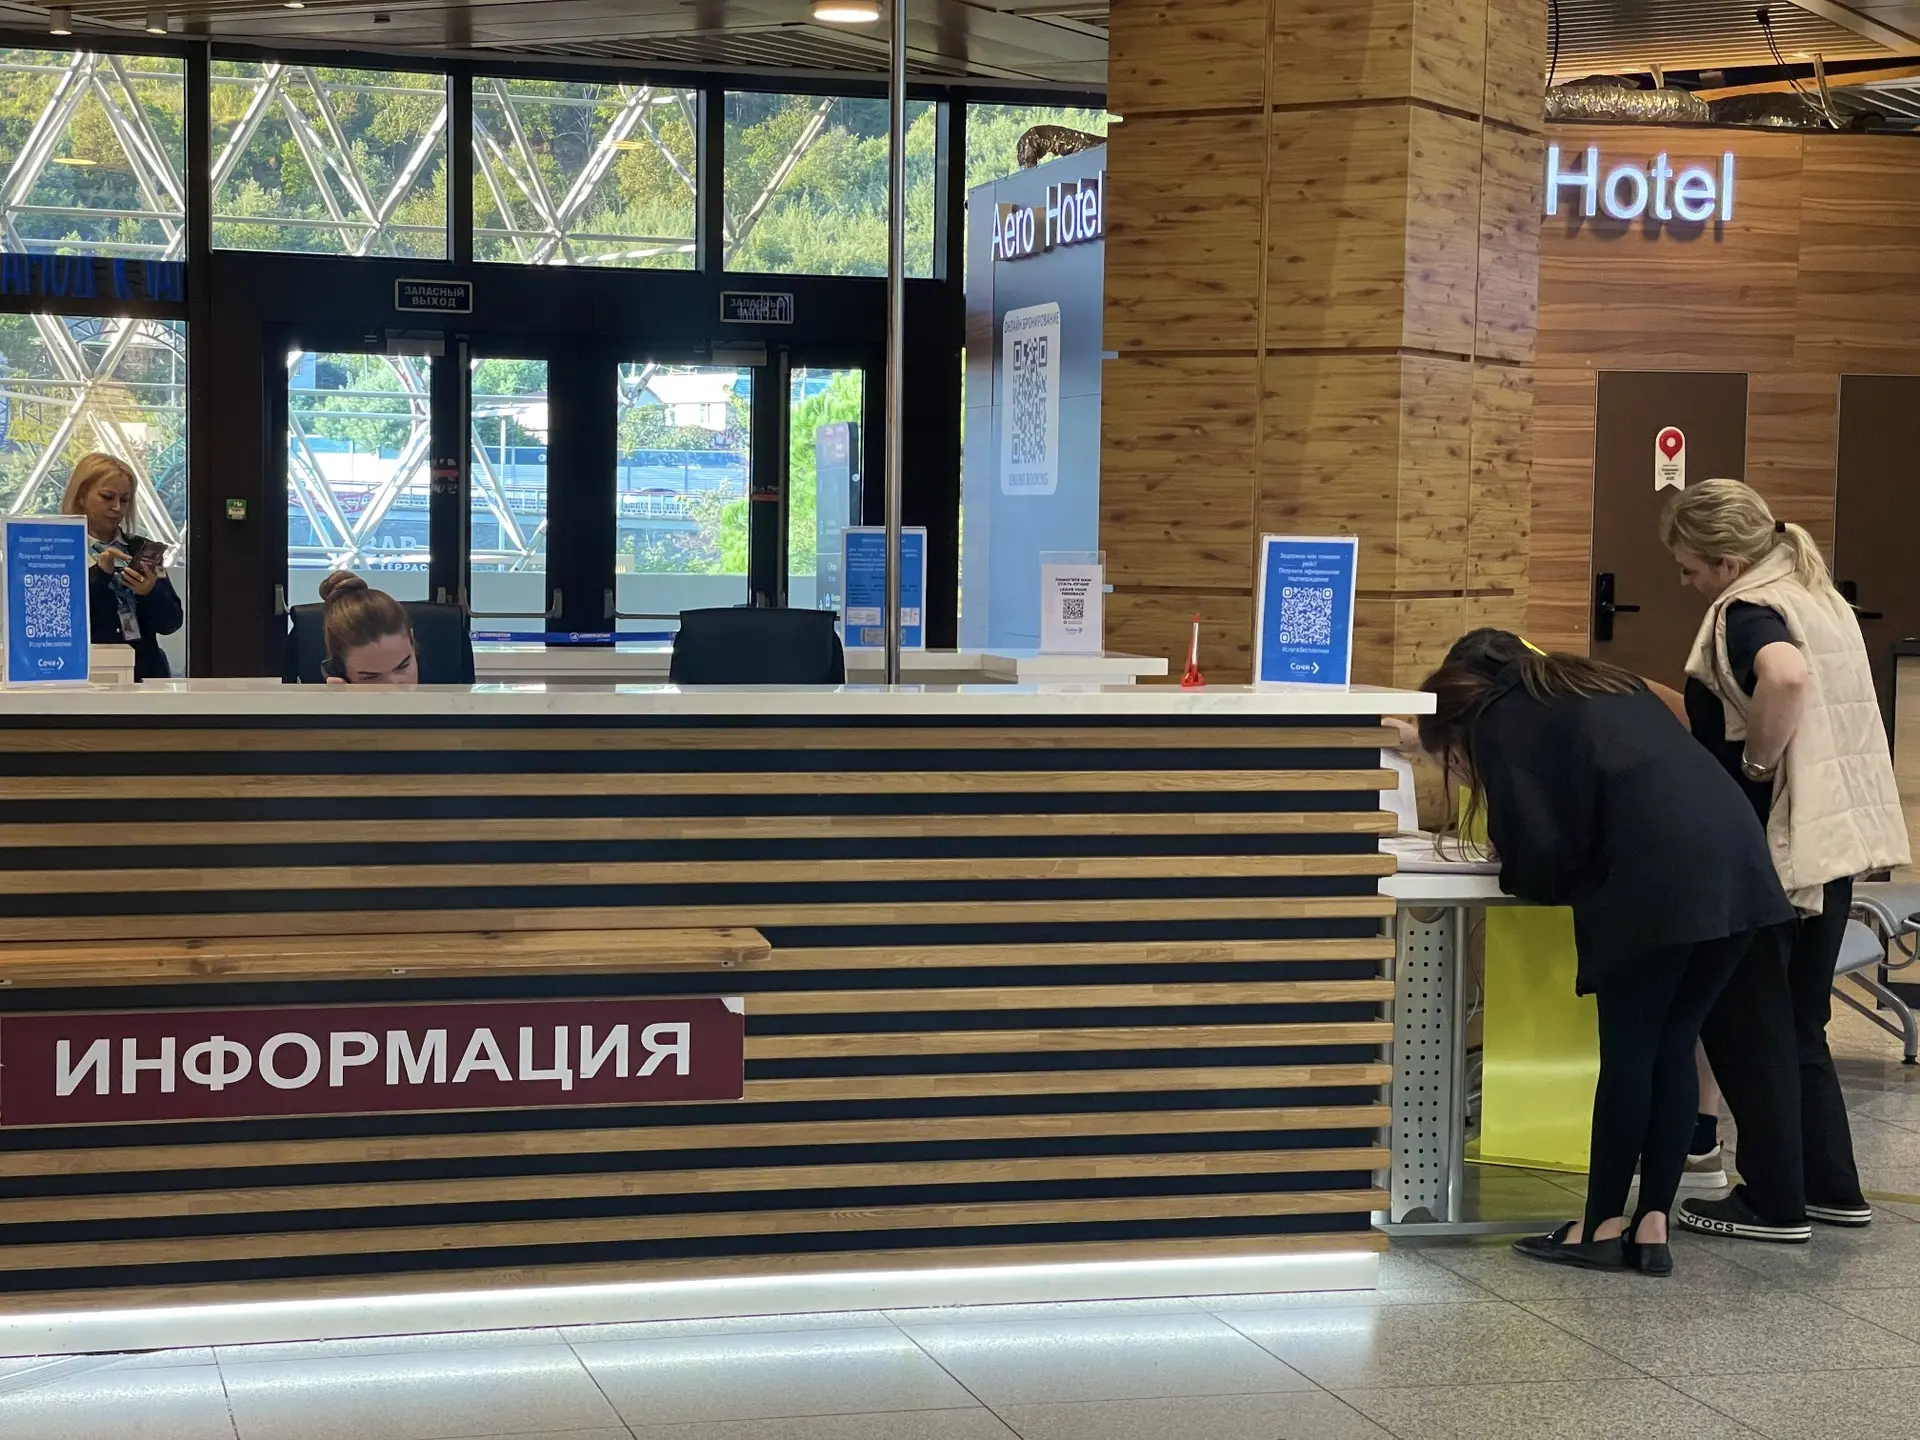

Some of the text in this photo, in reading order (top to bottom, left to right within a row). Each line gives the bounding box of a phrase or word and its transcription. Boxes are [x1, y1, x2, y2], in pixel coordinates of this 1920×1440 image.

[1546, 143, 1735, 221] Hotel
[991, 170, 1102, 262] Aero Hotel
[404, 286, 465, 298] ЗАПАСНЫЙ
[412, 296, 457, 308] ВЫХОД
[1290, 662, 1310, 671] Сочи
[55, 1021, 692, 1098] ИНФОРМАЦИЯ
[1687, 1215, 1735, 1233] crocs
